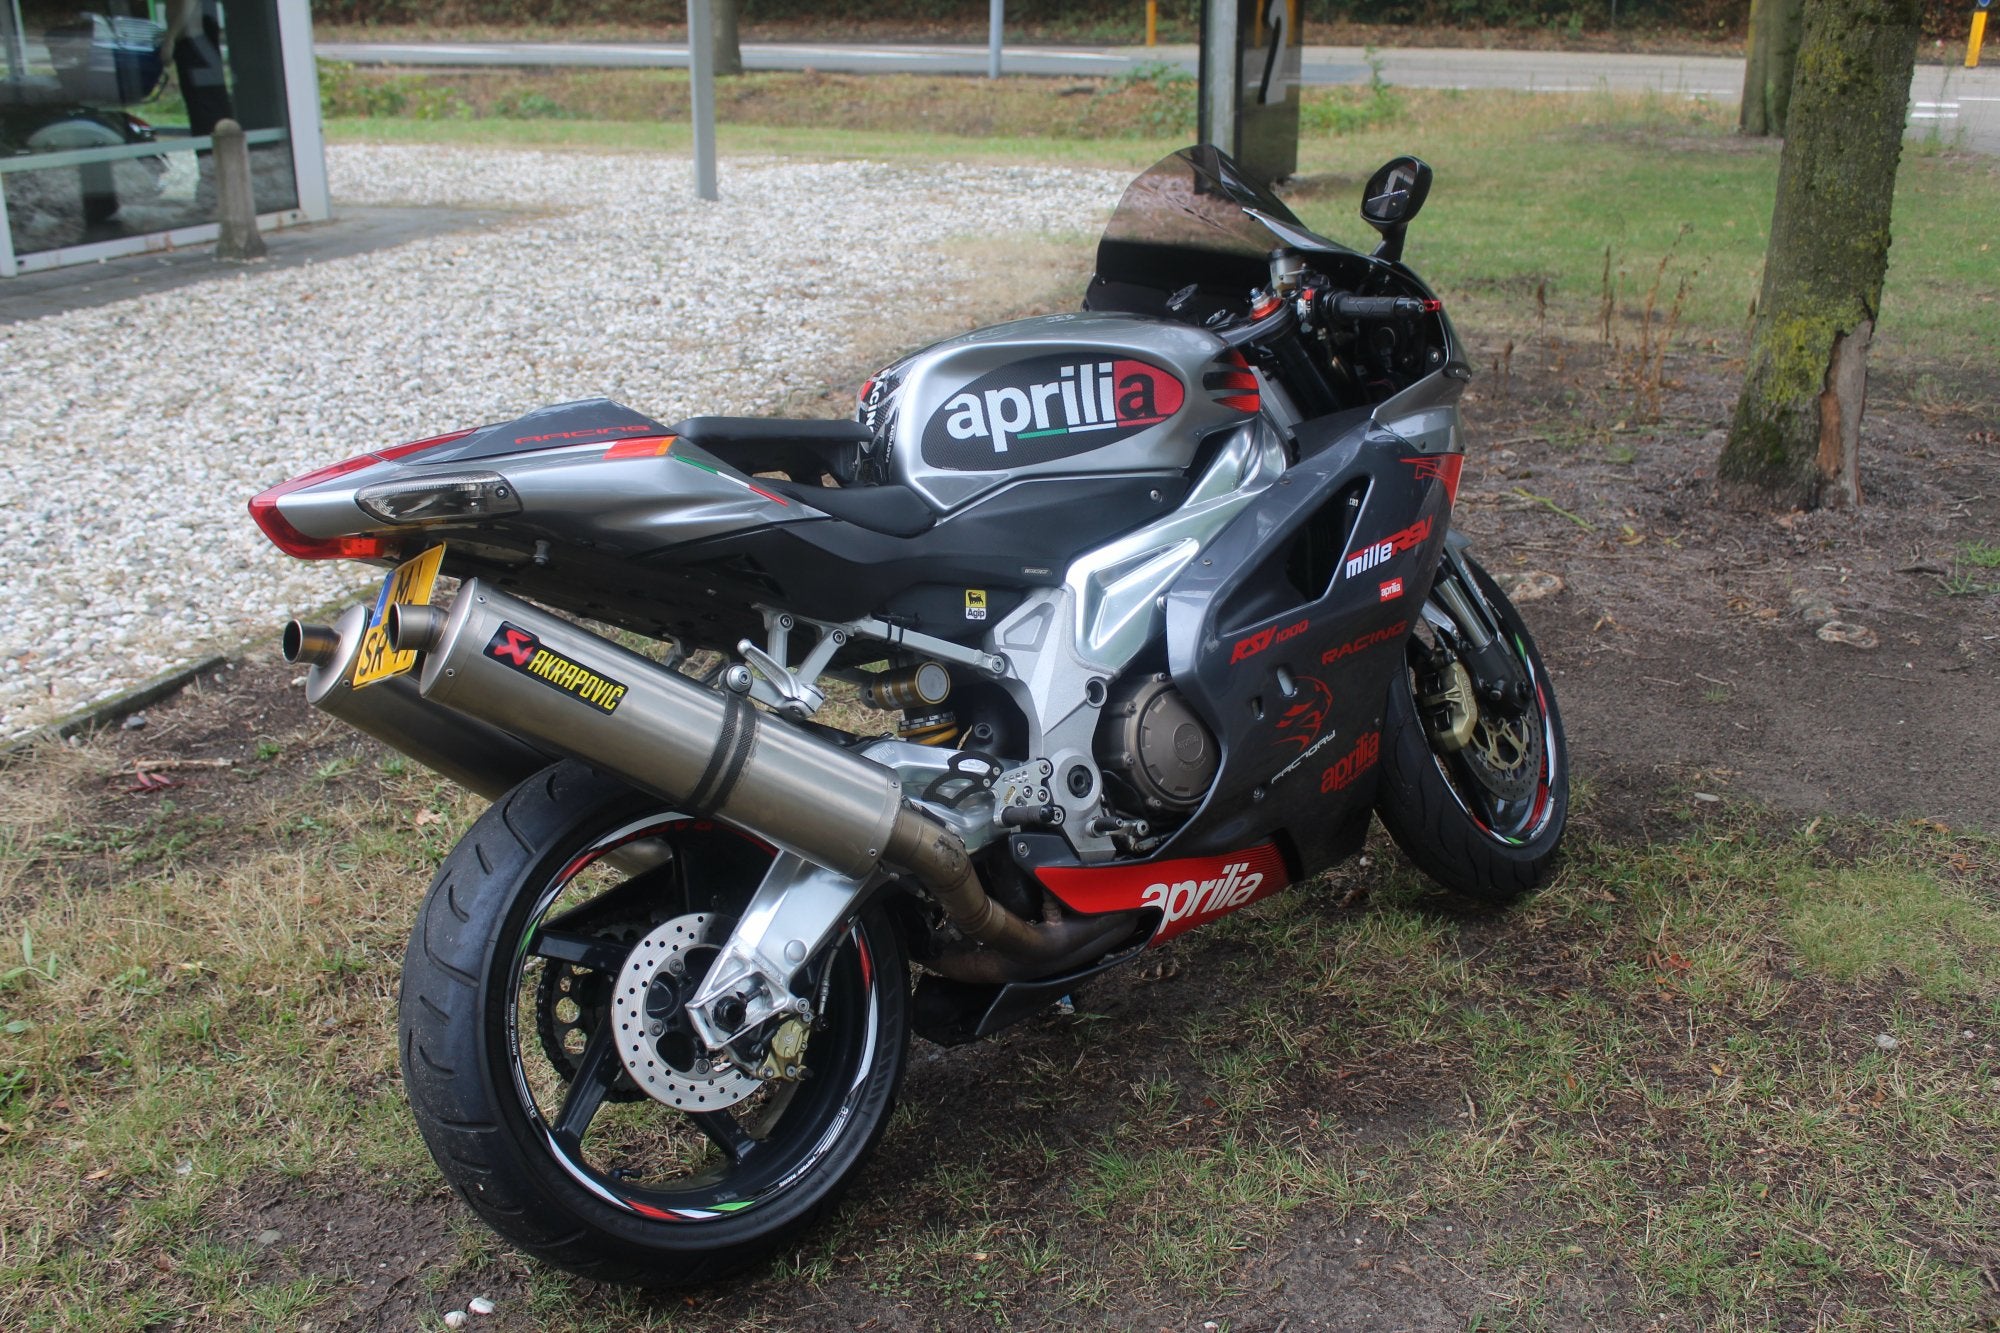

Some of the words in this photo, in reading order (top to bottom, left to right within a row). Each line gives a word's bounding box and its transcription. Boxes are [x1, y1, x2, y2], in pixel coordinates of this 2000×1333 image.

[944, 361, 1159, 453] aprilia
[1346, 542, 1392, 579] mille
[1380, 581, 1401, 598] aprilia
[967, 608, 985, 619] Agip
[1276, 619, 1310, 643] 1000
[1321, 620, 1408, 665] RACING
[1271, 729, 1336, 785] FACTORY
[1321, 732, 1379, 794] aprilia
[1140, 862, 1264, 936] aprilia
